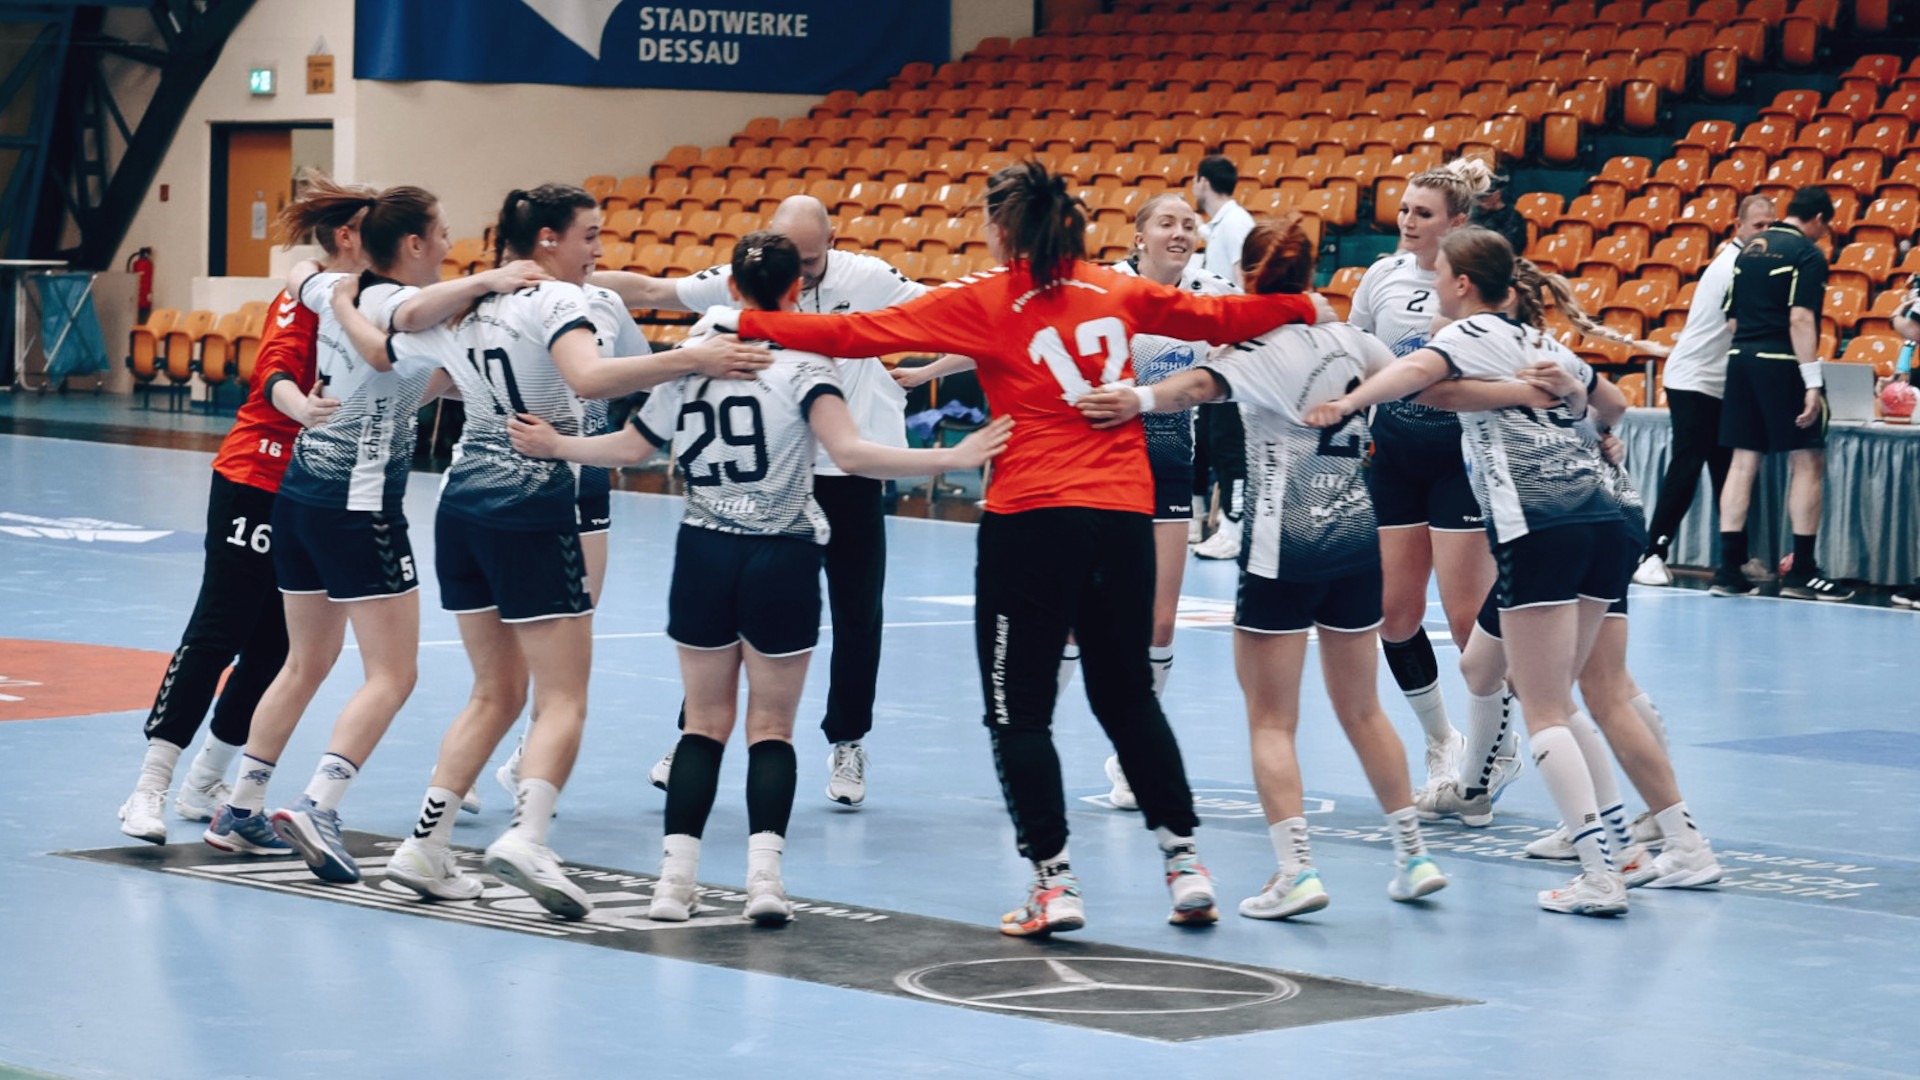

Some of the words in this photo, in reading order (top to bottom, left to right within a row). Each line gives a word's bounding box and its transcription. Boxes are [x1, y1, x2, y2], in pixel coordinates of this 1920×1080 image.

[639, 6, 808, 38] STADTWERKE
[638, 37, 740, 65] DESSAU
[1406, 289, 1430, 313] 2
[257, 438, 284, 458] 16
[676, 395, 769, 487] 29
[226, 516, 272, 554] 16
[399, 555, 415, 582] 5
[1717, 876, 1862, 900] HIGH
[1750, 870, 1880, 890] FOR
